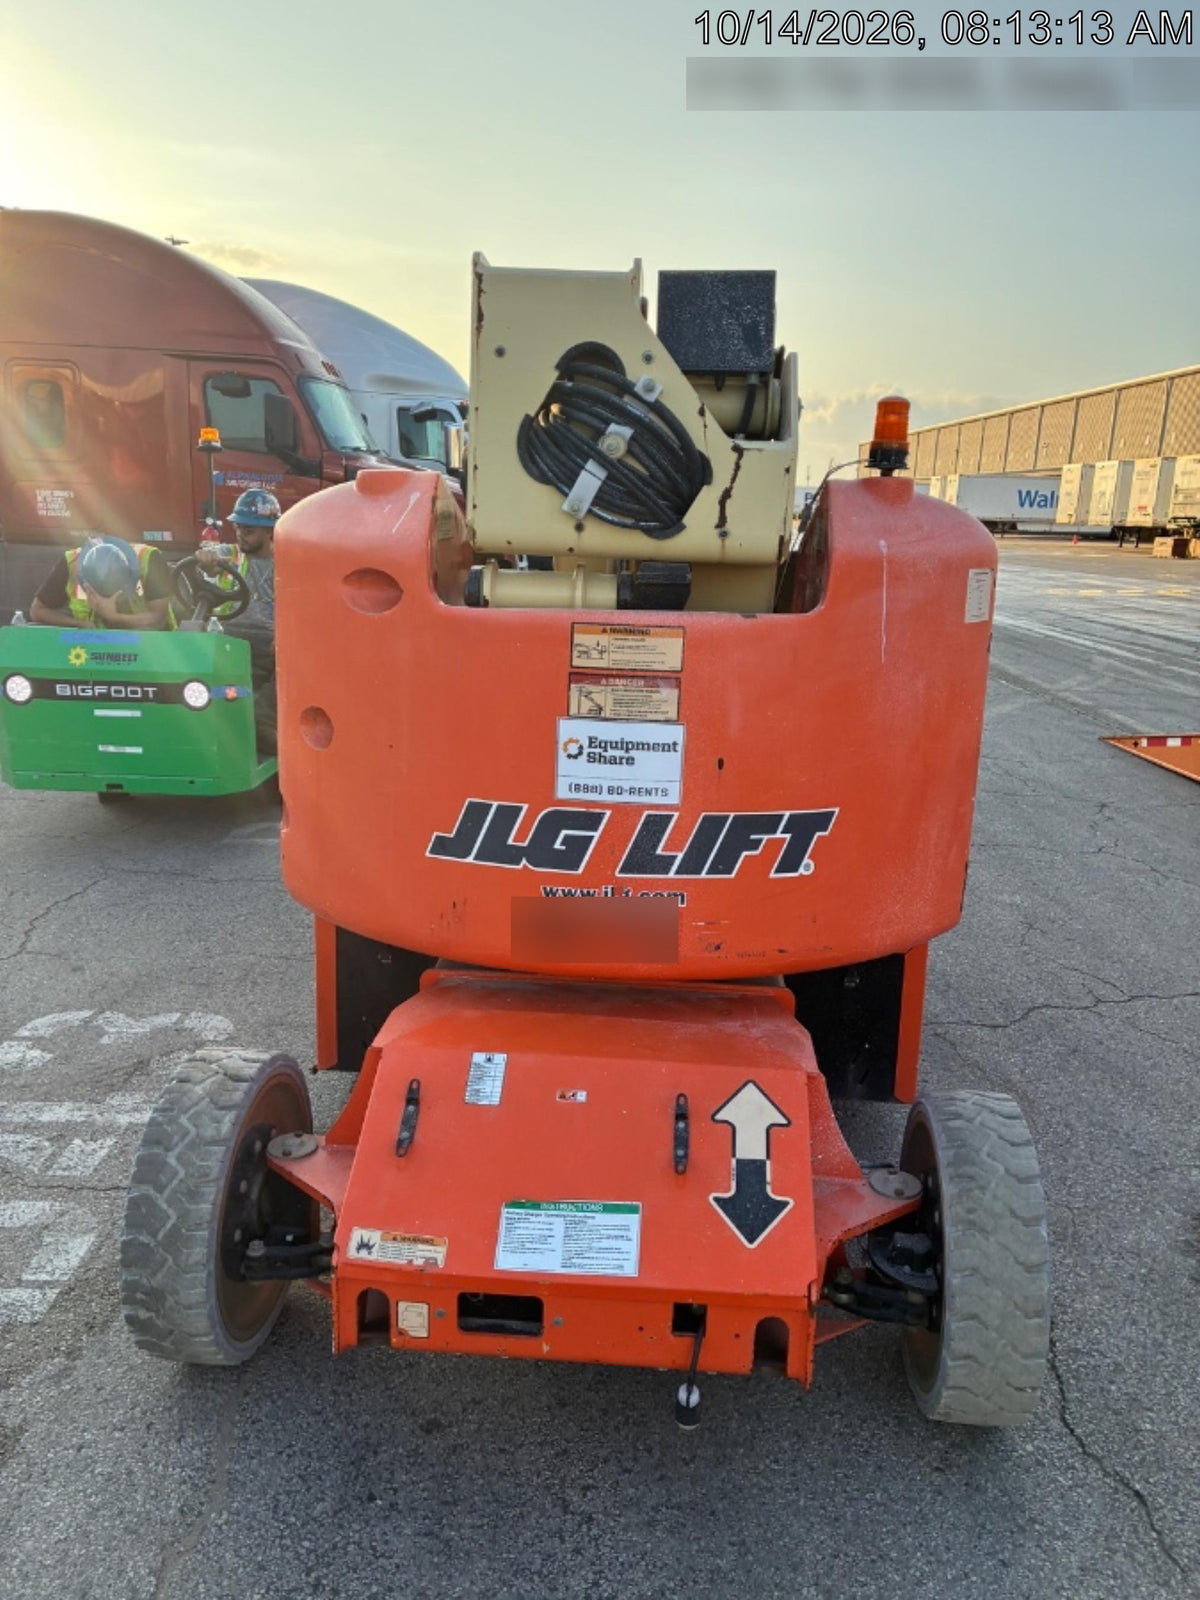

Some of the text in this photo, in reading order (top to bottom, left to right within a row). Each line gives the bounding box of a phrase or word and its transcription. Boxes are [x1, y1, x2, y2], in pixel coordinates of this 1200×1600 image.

[1017, 489, 1059, 509] Wal
[56, 683, 158, 699] BIGFOOT
[587, 736, 679, 754] Equipment
[586, 752, 636, 766] Share
[425, 798, 612, 874] JLG
